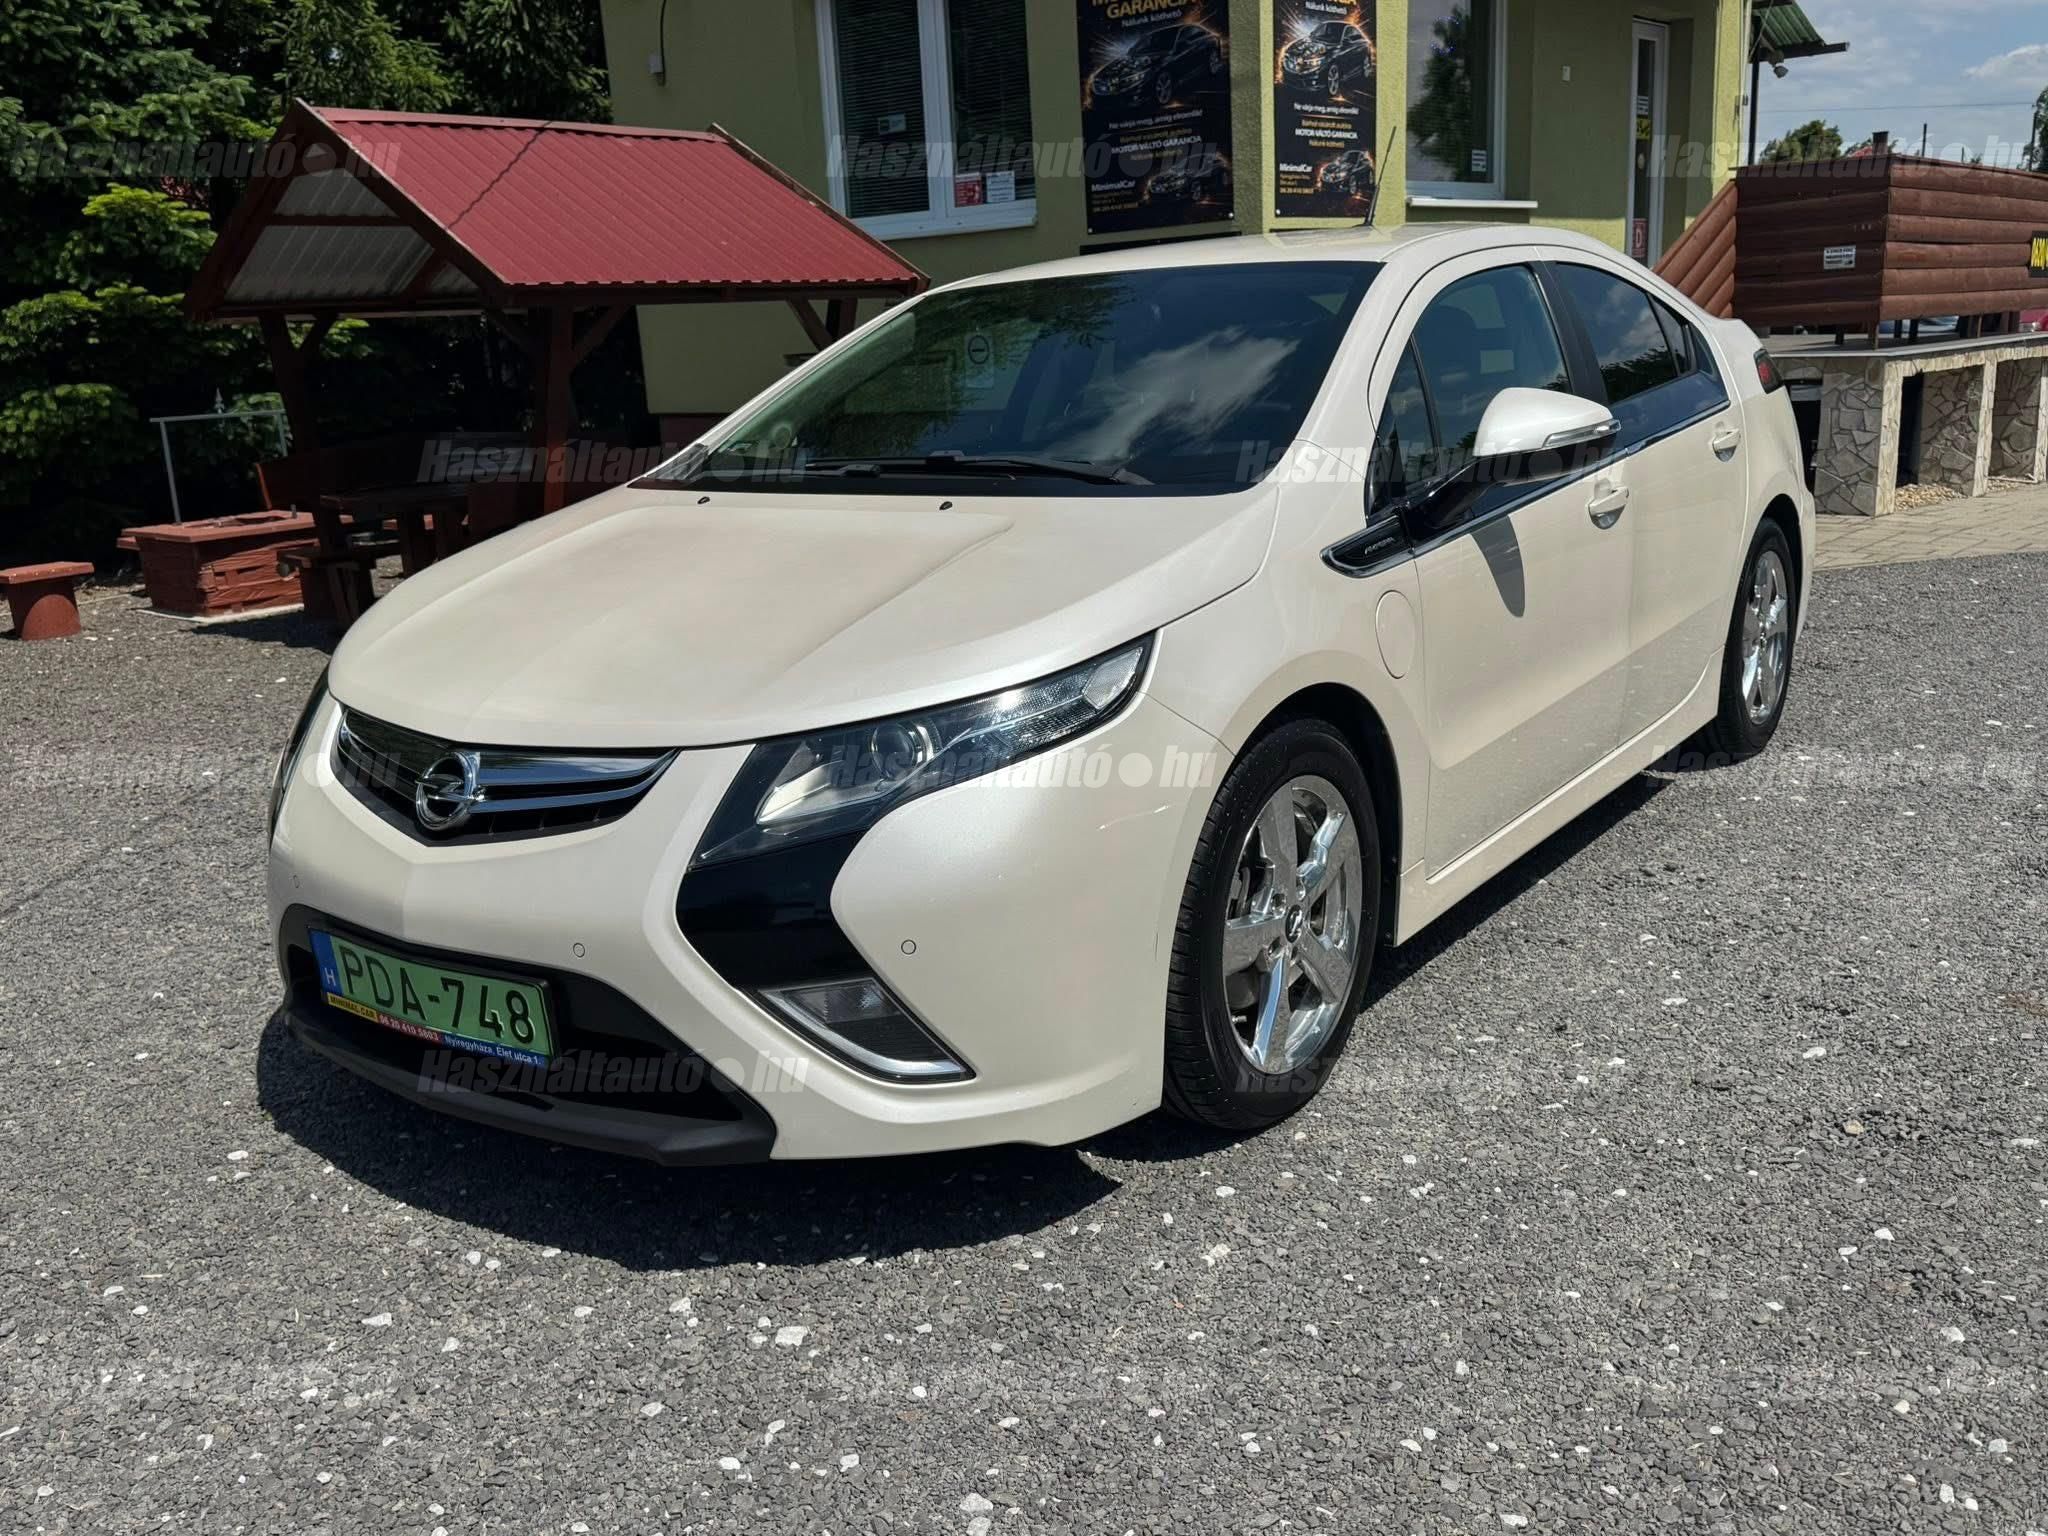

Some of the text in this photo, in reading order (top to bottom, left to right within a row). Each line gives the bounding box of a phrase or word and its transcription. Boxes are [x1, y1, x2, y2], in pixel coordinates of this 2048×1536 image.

[1106, 0, 1199, 19] GARANC
[1091, 179, 1136, 192] MinimalCar
[326, 967, 336, 986] H
[342, 948, 535, 1043] PDA-748
